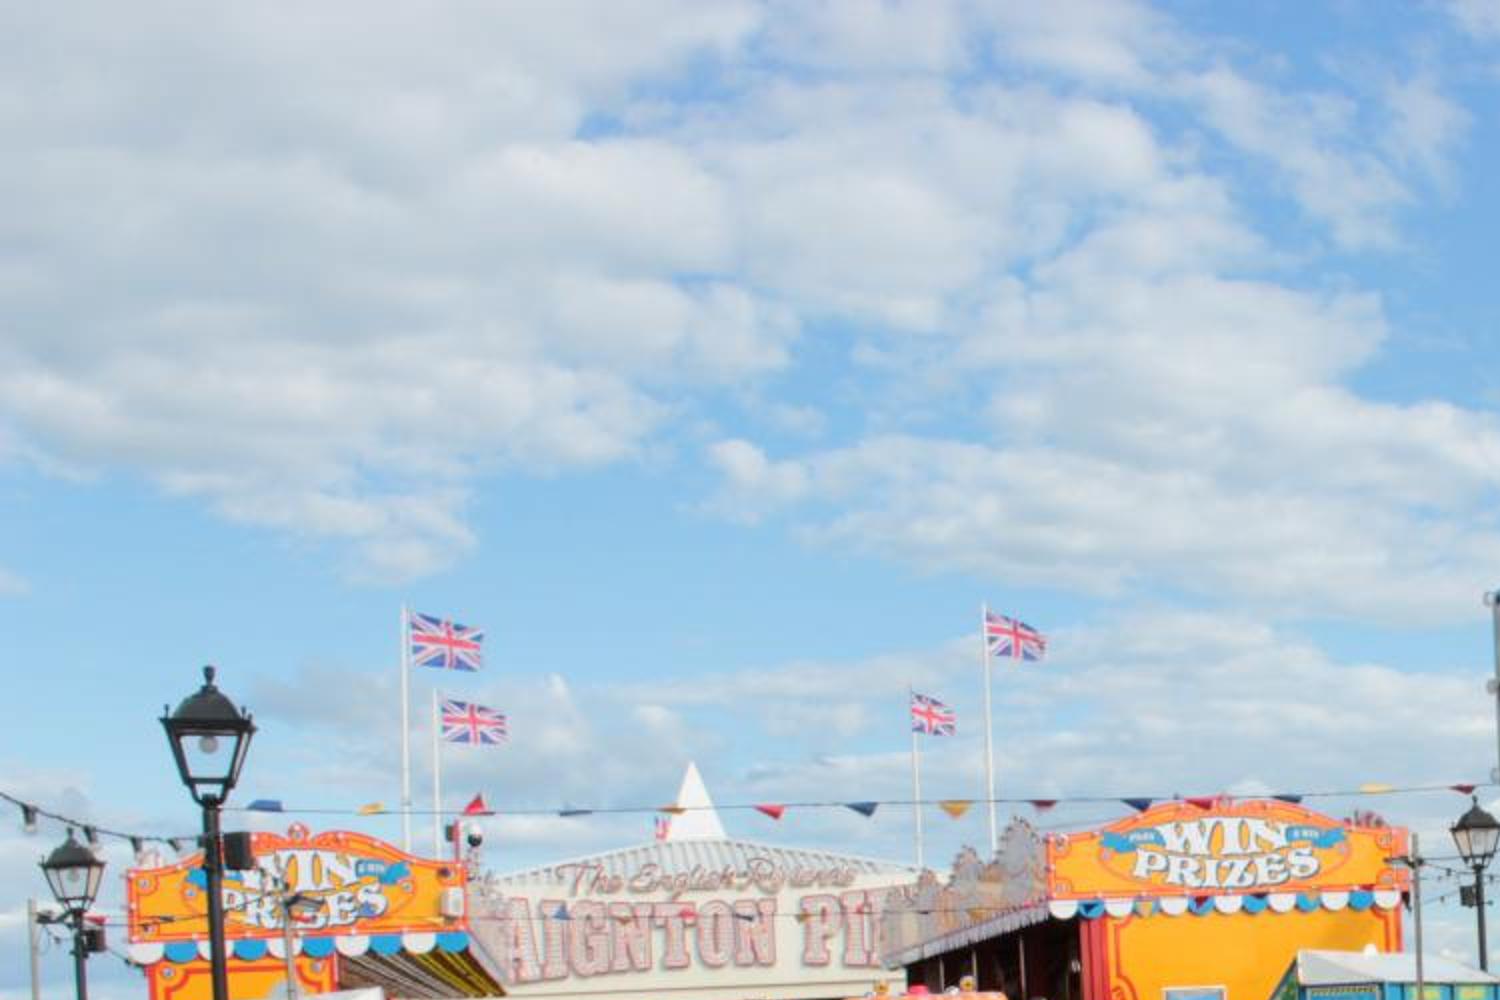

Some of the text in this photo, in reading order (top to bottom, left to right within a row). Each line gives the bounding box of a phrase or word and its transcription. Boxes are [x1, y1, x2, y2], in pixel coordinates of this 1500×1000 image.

[1156, 816, 1289, 855] WIN
[556, 863, 624, 896] The
[1133, 846, 1321, 889] PRIZES
[506, 885, 884, 984] AIGNTON PI
